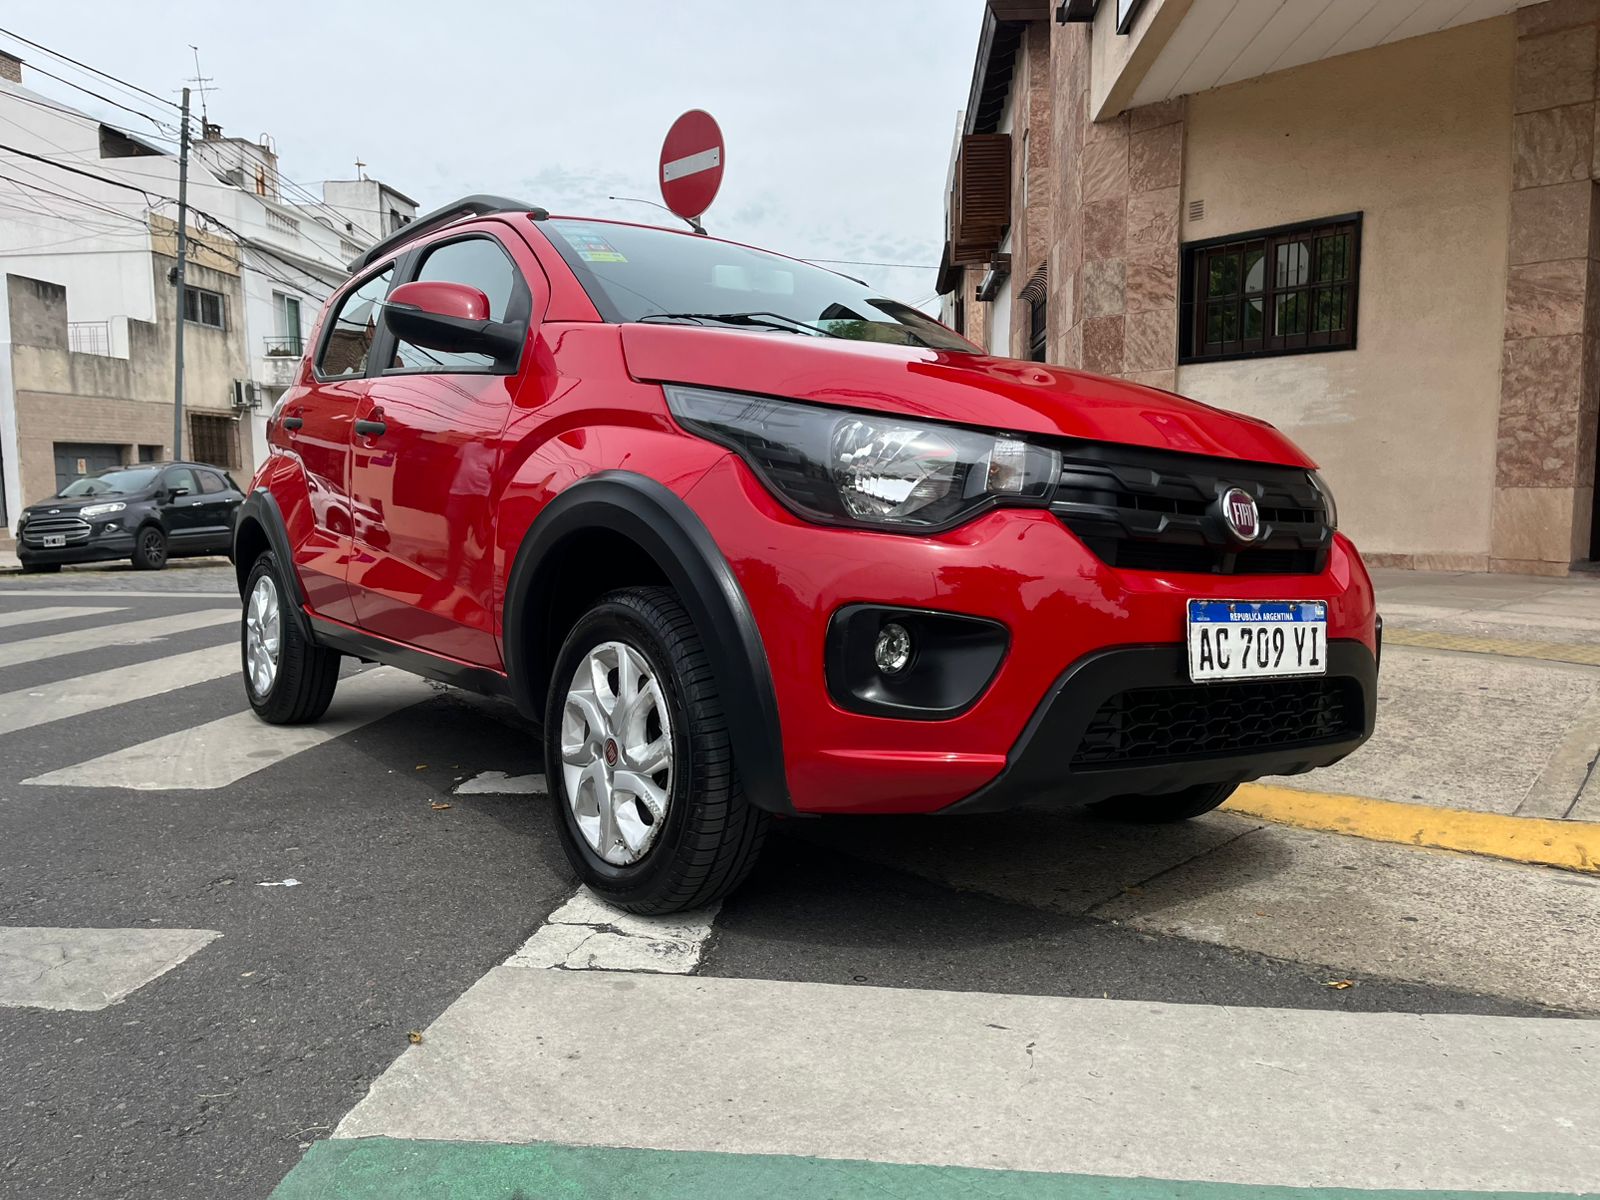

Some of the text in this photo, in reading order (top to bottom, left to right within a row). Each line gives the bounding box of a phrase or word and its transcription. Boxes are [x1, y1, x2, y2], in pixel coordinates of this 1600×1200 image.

[1232, 502, 1253, 527] FIAT
[1230, 612, 1294, 621] REPUBLICA ARGENTINA
[1200, 627, 1319, 671] AC 709 YI
